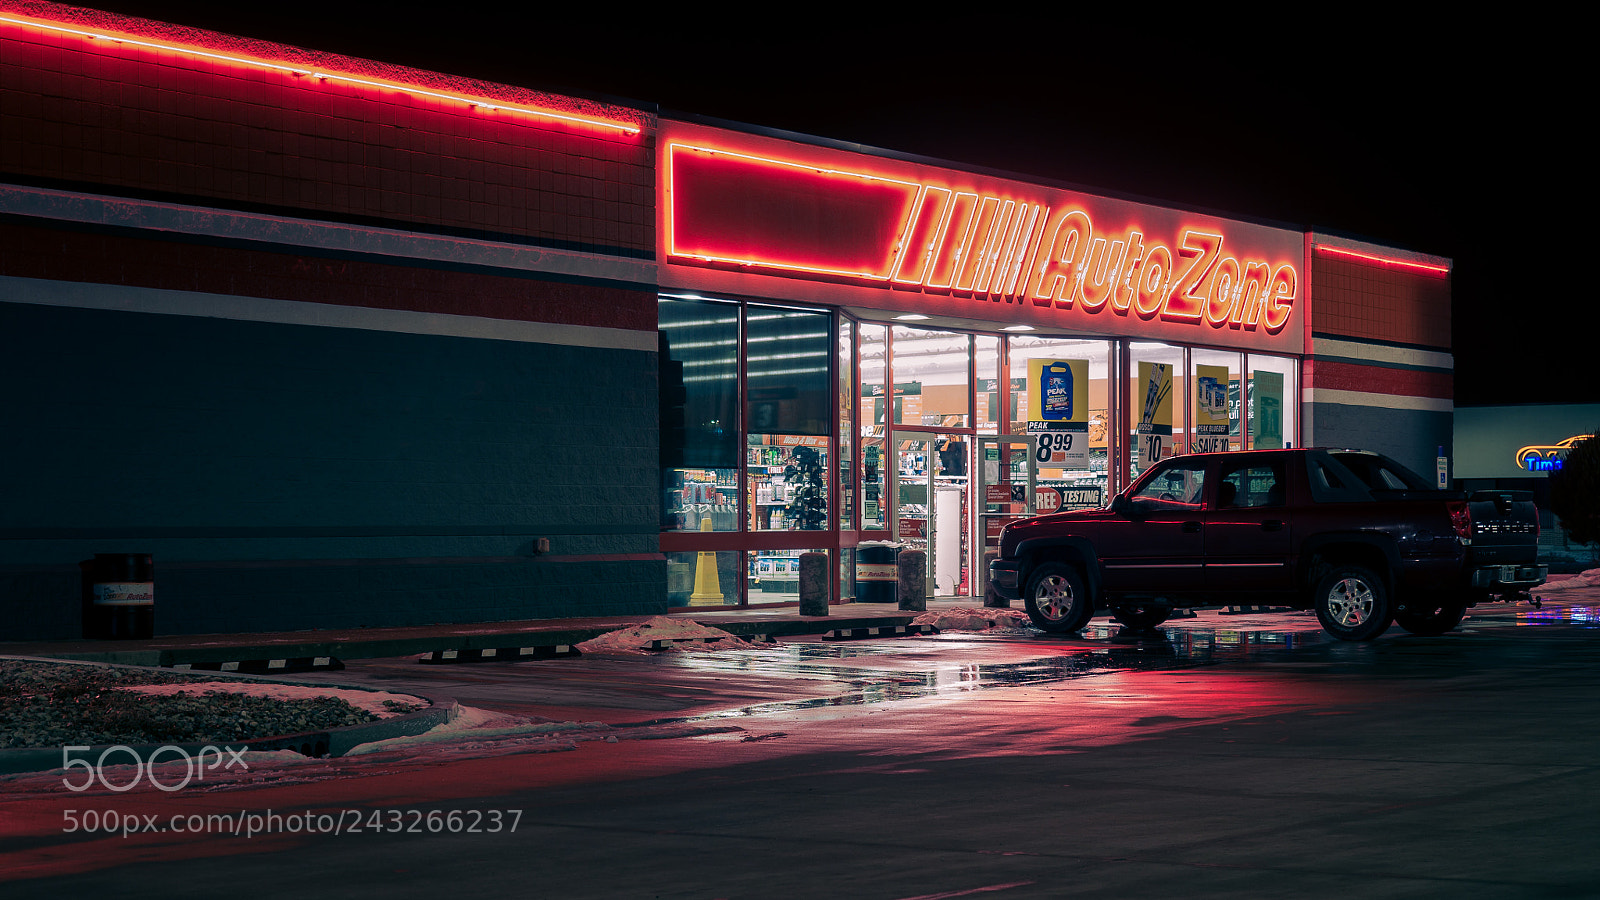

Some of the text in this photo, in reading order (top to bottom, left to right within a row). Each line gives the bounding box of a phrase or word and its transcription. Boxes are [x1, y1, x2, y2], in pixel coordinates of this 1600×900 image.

[1033, 209, 1298, 335] AutoZone
[1047, 388, 1067, 396] PEAK
[783, 436, 799, 445] Wash
[1198, 438, 1218, 453] SAVE
[1145, 435, 1162, 462] $10
[1525, 456, 1562, 471] Tim's
[1036, 490, 1099, 510] REE TESTING
